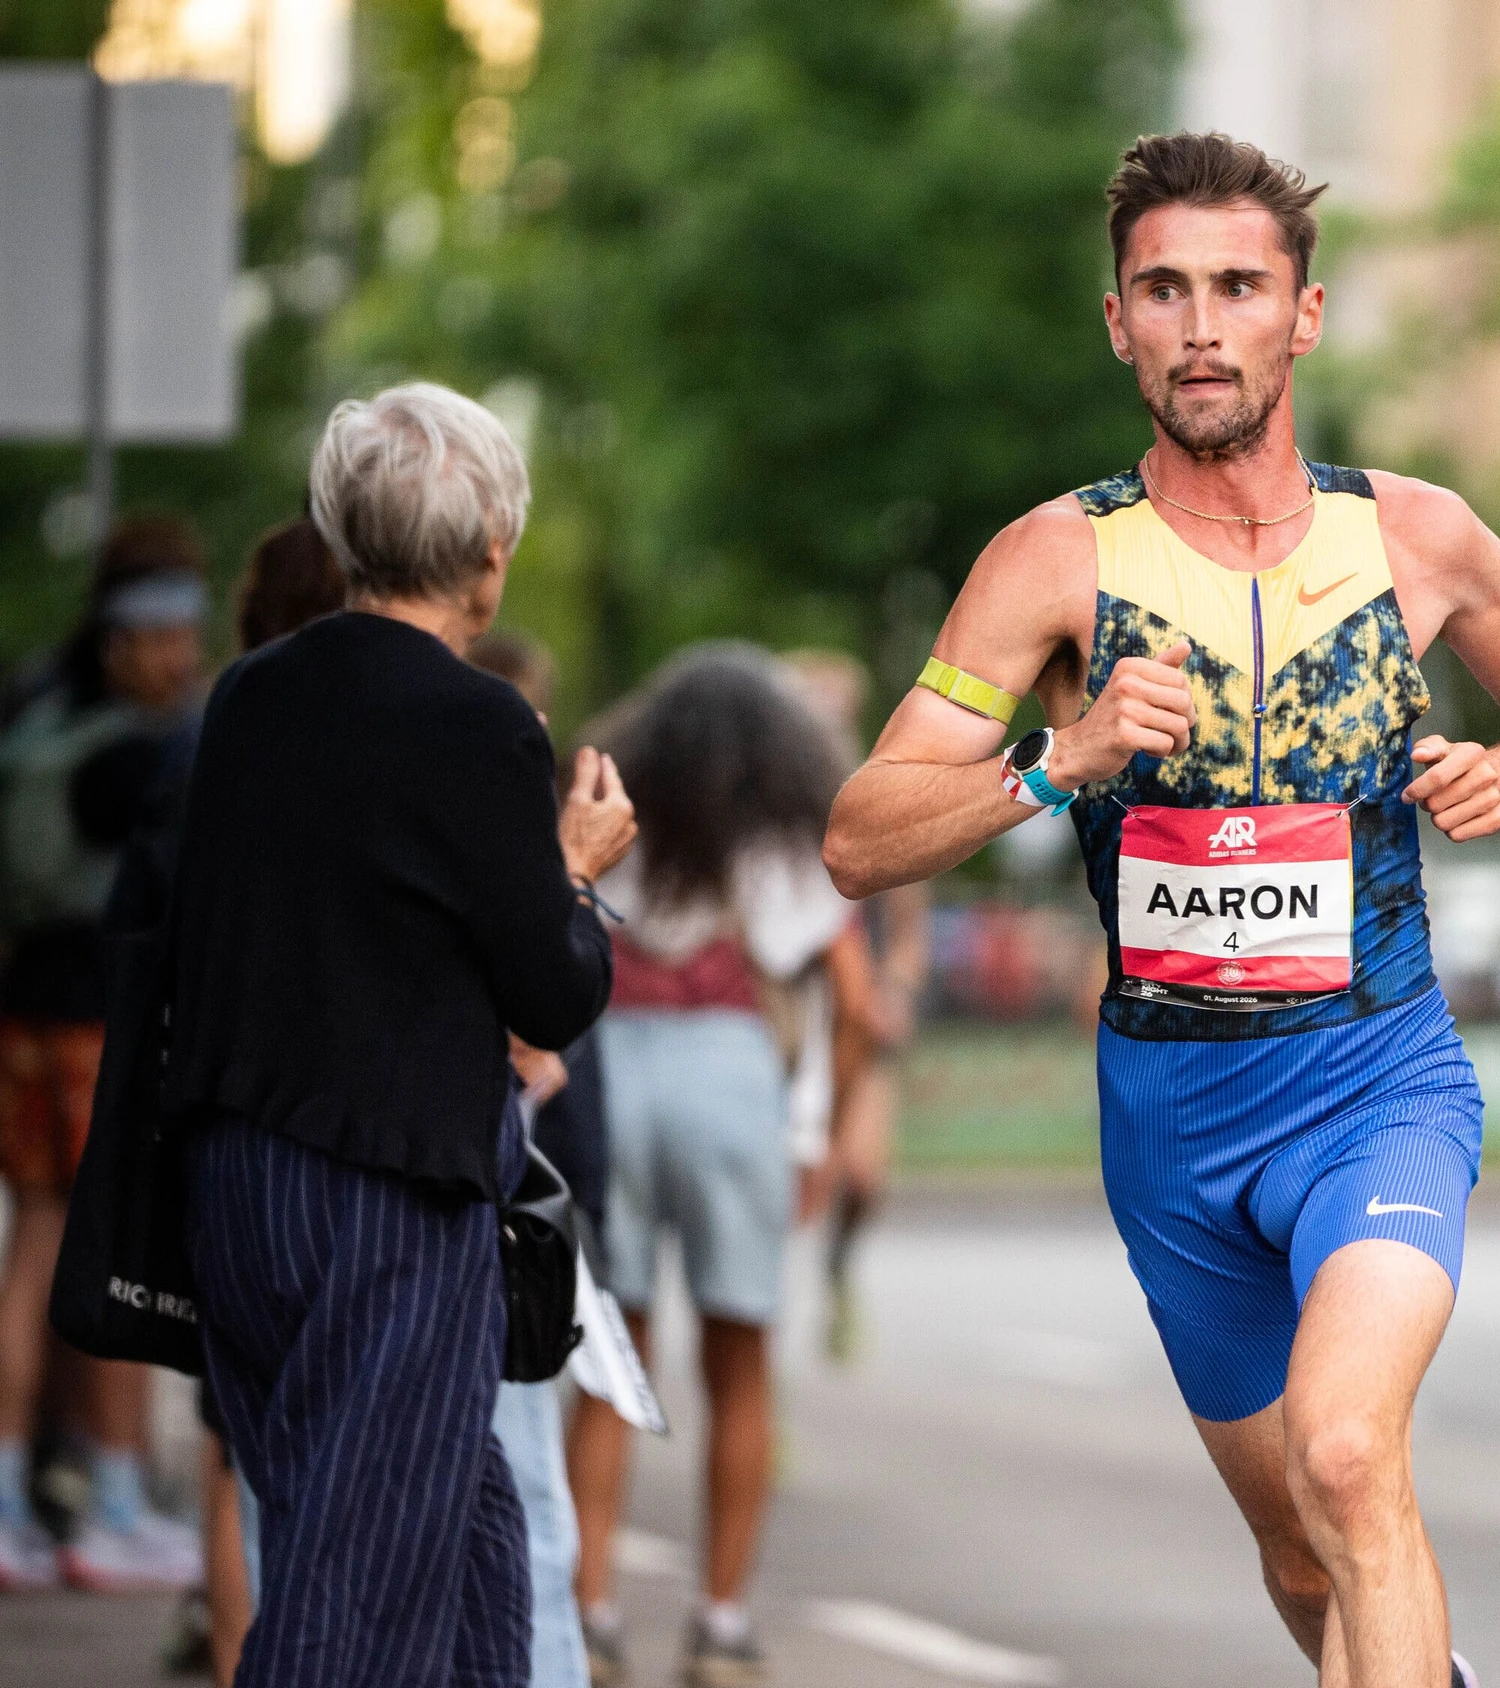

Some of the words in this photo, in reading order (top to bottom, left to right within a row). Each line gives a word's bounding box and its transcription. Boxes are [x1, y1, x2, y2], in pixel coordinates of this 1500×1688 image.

[1207, 816, 1258, 848] AR
[1146, 883, 1318, 920] AARON
[1222, 931, 1239, 953] 4
[1141, 985, 1168, 995] NIGHT
